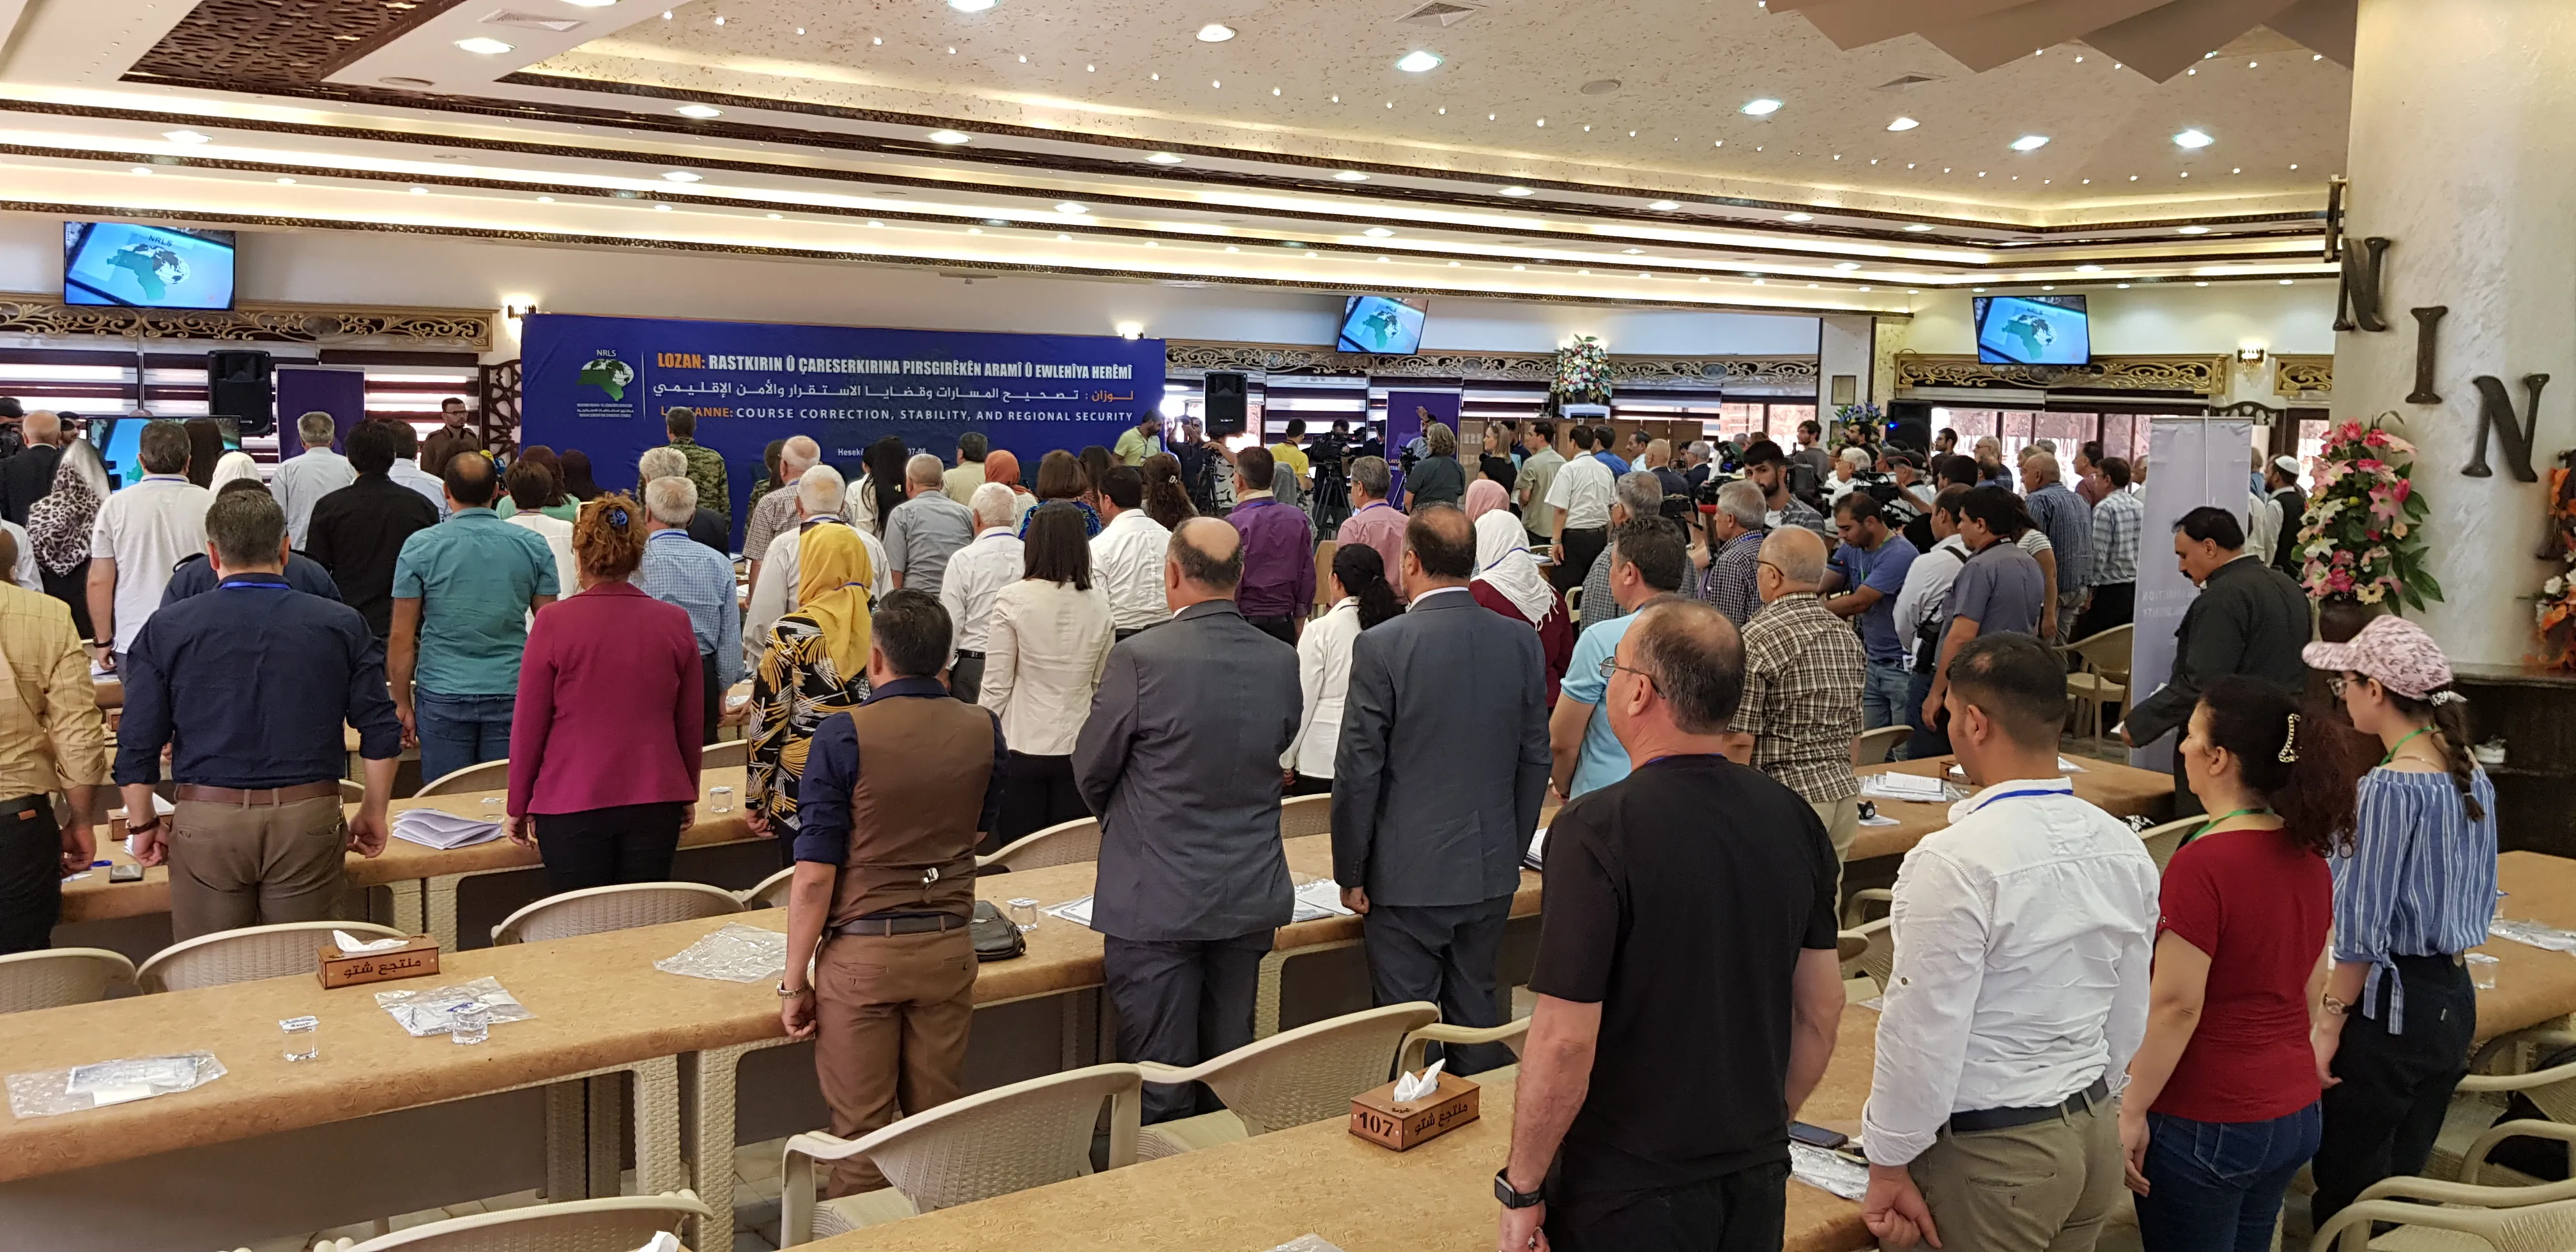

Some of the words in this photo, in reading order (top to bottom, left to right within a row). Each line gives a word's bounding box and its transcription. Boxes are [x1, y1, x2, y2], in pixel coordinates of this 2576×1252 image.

[149, 235, 172, 247] NRLS
[596, 349, 617, 357] NRLS
[657, 352, 705, 369] LOZAN:
[709, 355, 783, 372] RASTKIRIN
[786, 355, 795, 372] Û
[799, 357, 900, 375] ÇARESERKIRINA
[902, 359, 981, 376] PIRSGIRÊKÊN
[984, 361, 1023, 378] ARAMÎ
[1035, 363, 1090, 379] EWLEHÎYA
[1092, 363, 1133, 379] HERÊMÎ
[653, 381, 732, 399] الإقليمي
[788, 384, 861, 398] الاستقرار
[865, 385, 933, 400] وقضايا
[936, 386, 999, 401] المسارات
[1002, 390, 1079, 403] تصحيح
[1091, 390, 1133, 402] لوزان
[660, 406, 733, 418] LANNE:
[736, 408, 793, 418] COURSE
[800, 408, 894, 421] CORRECTION,
[900, 409, 970, 422] STABILITY,
[976, 411, 1003, 420] AND
[1008, 411, 1071, 421] REGIONAL
[1075, 412, 1133, 421] SECURITY
[1360, 1112, 1393, 1137] 107
